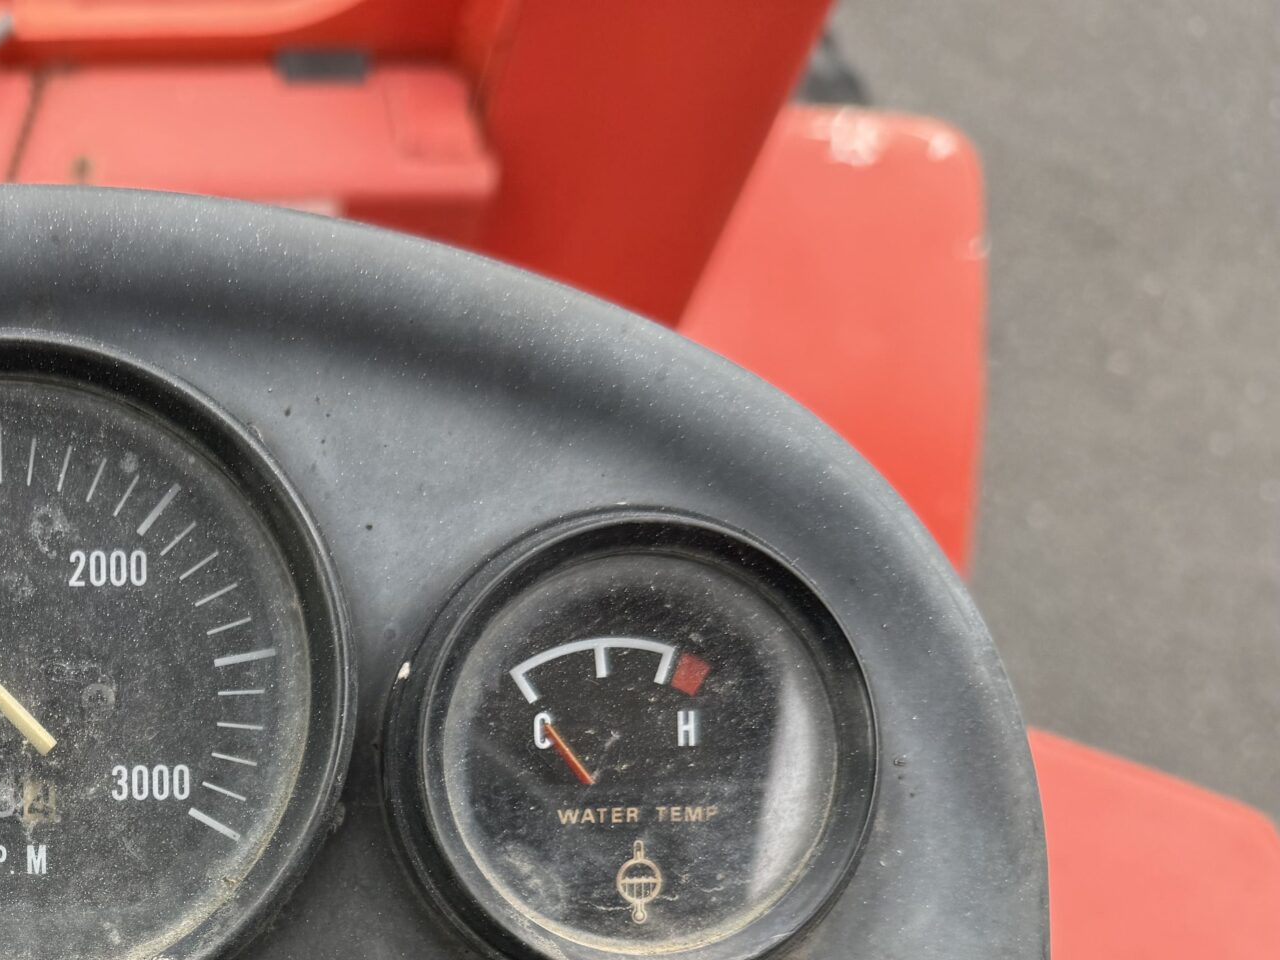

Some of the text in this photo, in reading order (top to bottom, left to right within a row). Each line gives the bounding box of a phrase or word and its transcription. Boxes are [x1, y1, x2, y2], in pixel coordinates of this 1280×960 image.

[68, 550, 147, 587] 2000
[533, 712, 553, 750] C
[676, 710, 698, 746] H
[111, 764, 190, 800] 3000
[557, 806, 719, 824] WATER TEMP
